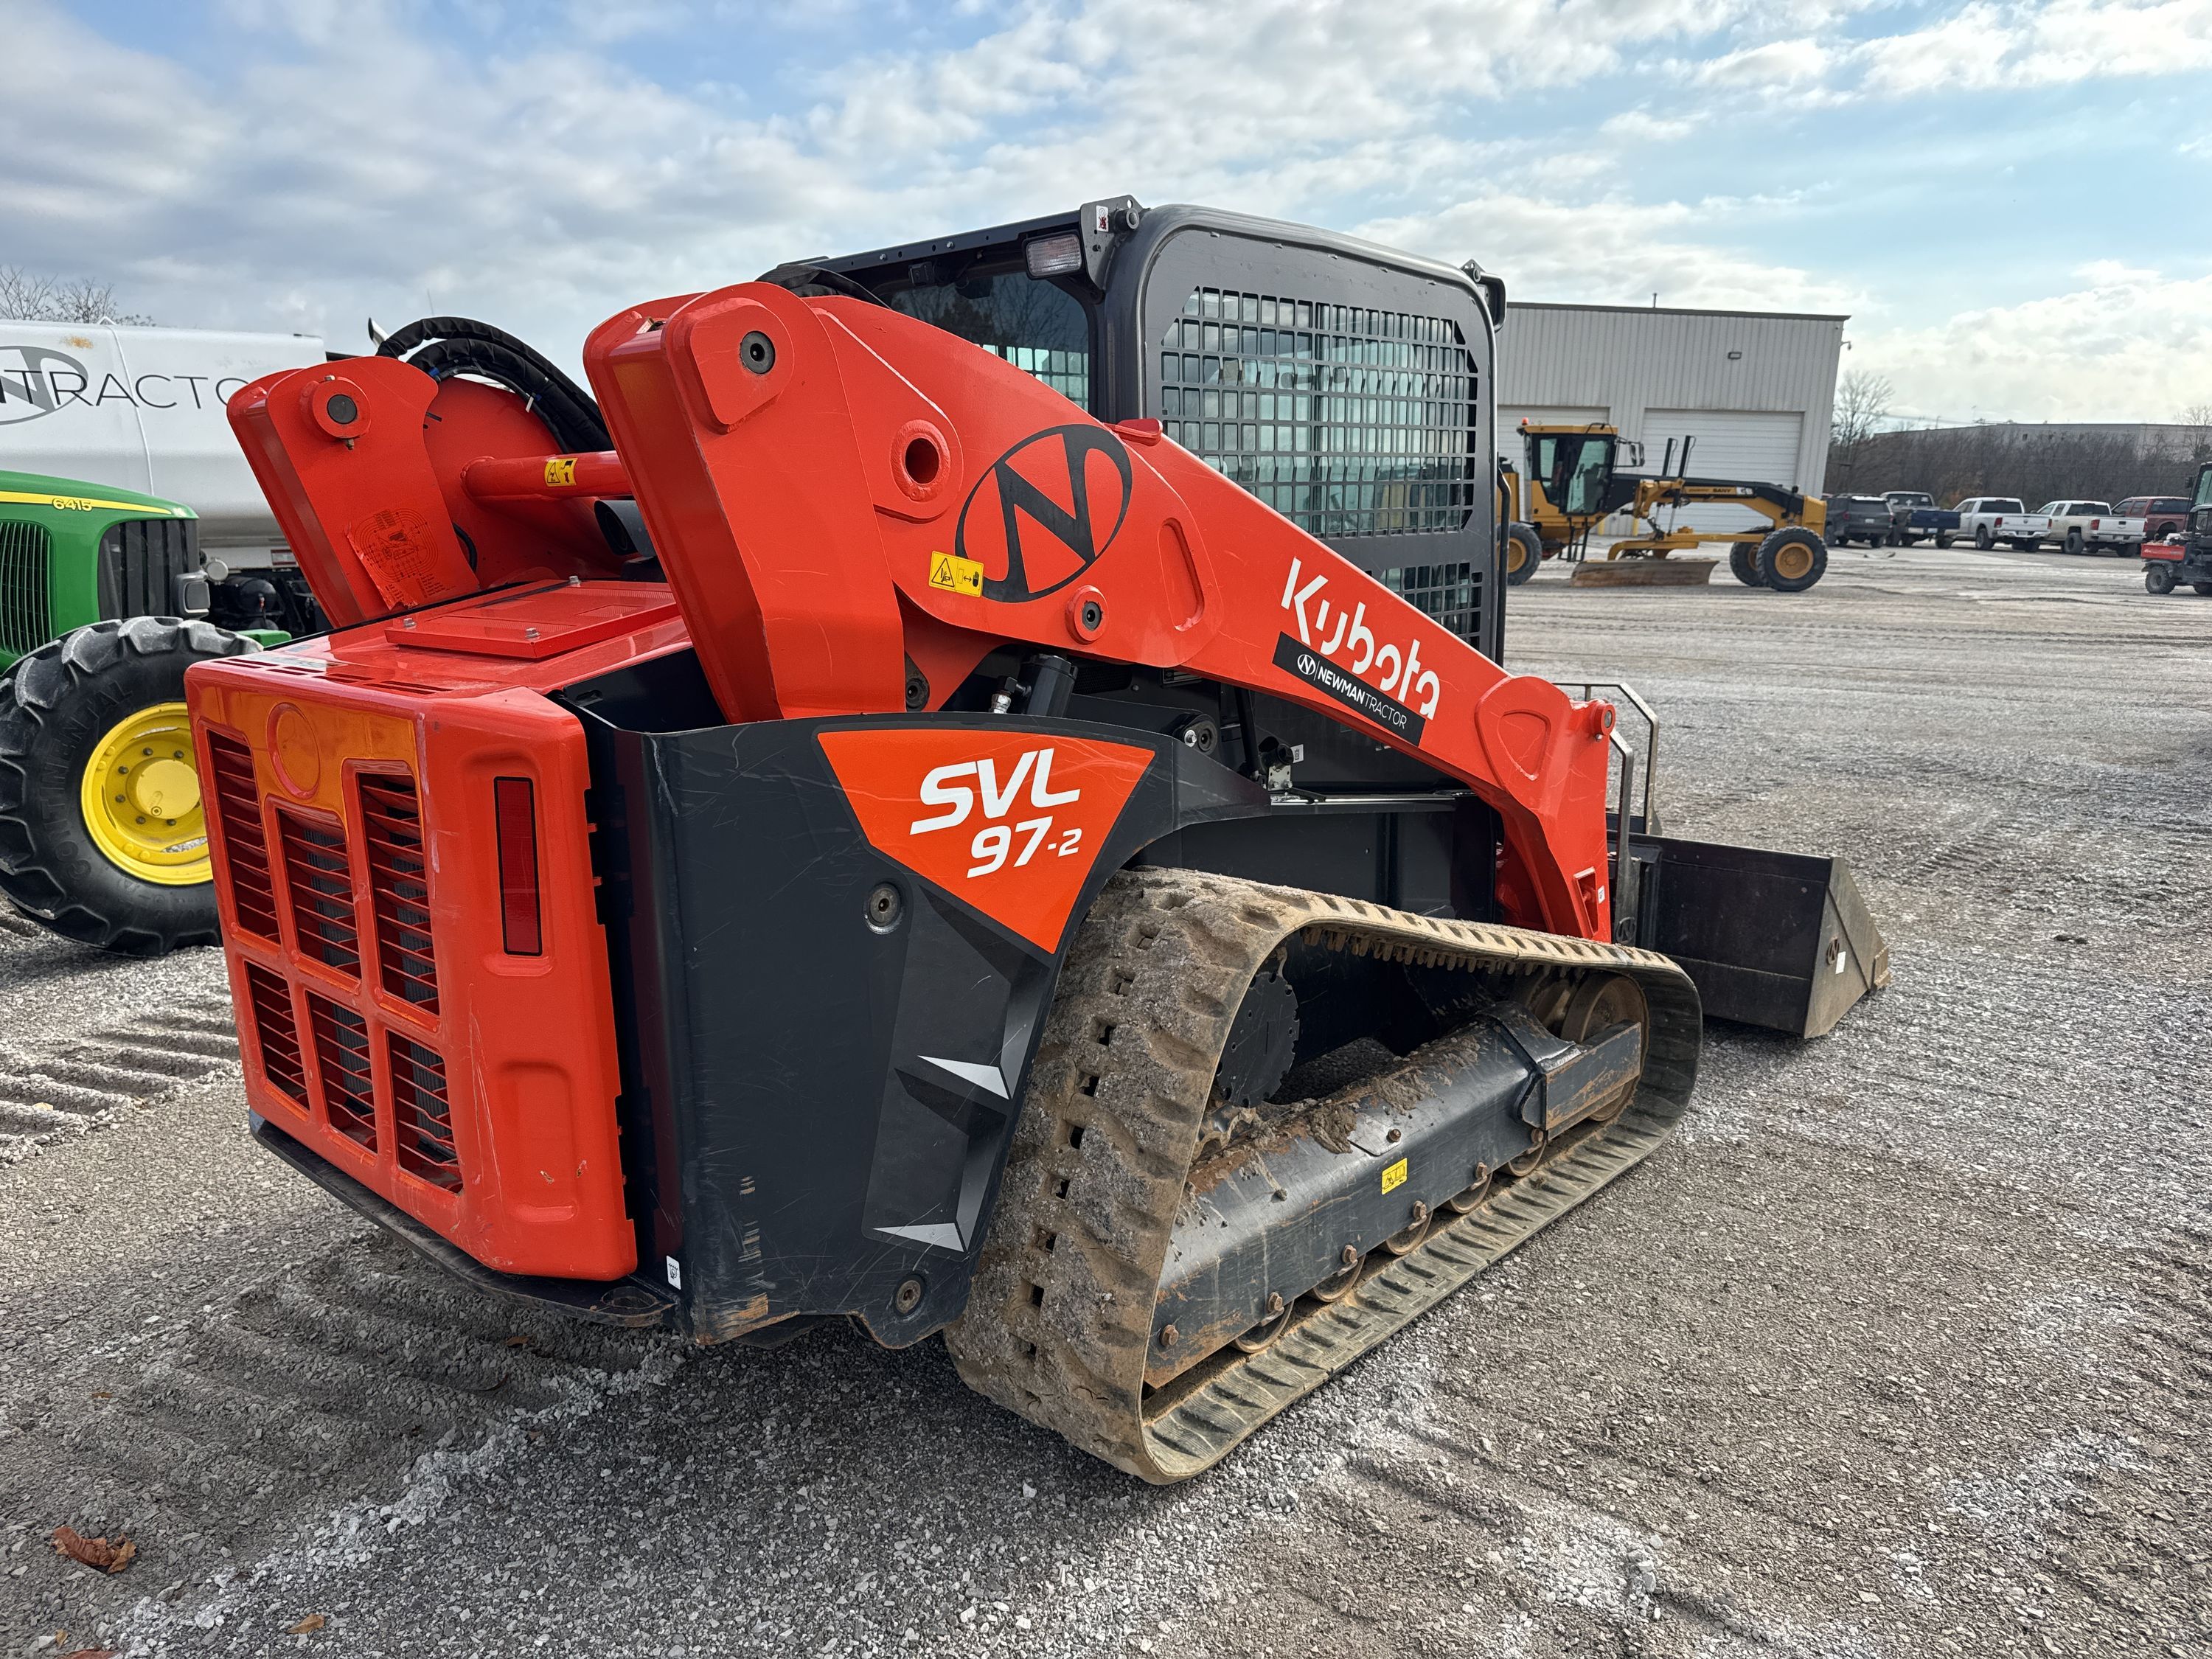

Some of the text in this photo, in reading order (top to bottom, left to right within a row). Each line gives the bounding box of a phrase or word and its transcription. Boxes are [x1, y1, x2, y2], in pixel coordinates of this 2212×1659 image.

[52, 498, 93, 512] 6415
[1280, 556, 1441, 720] Kubota
[909, 748, 1081, 835] SVL
[967, 815, 1082, 878] 97-2
